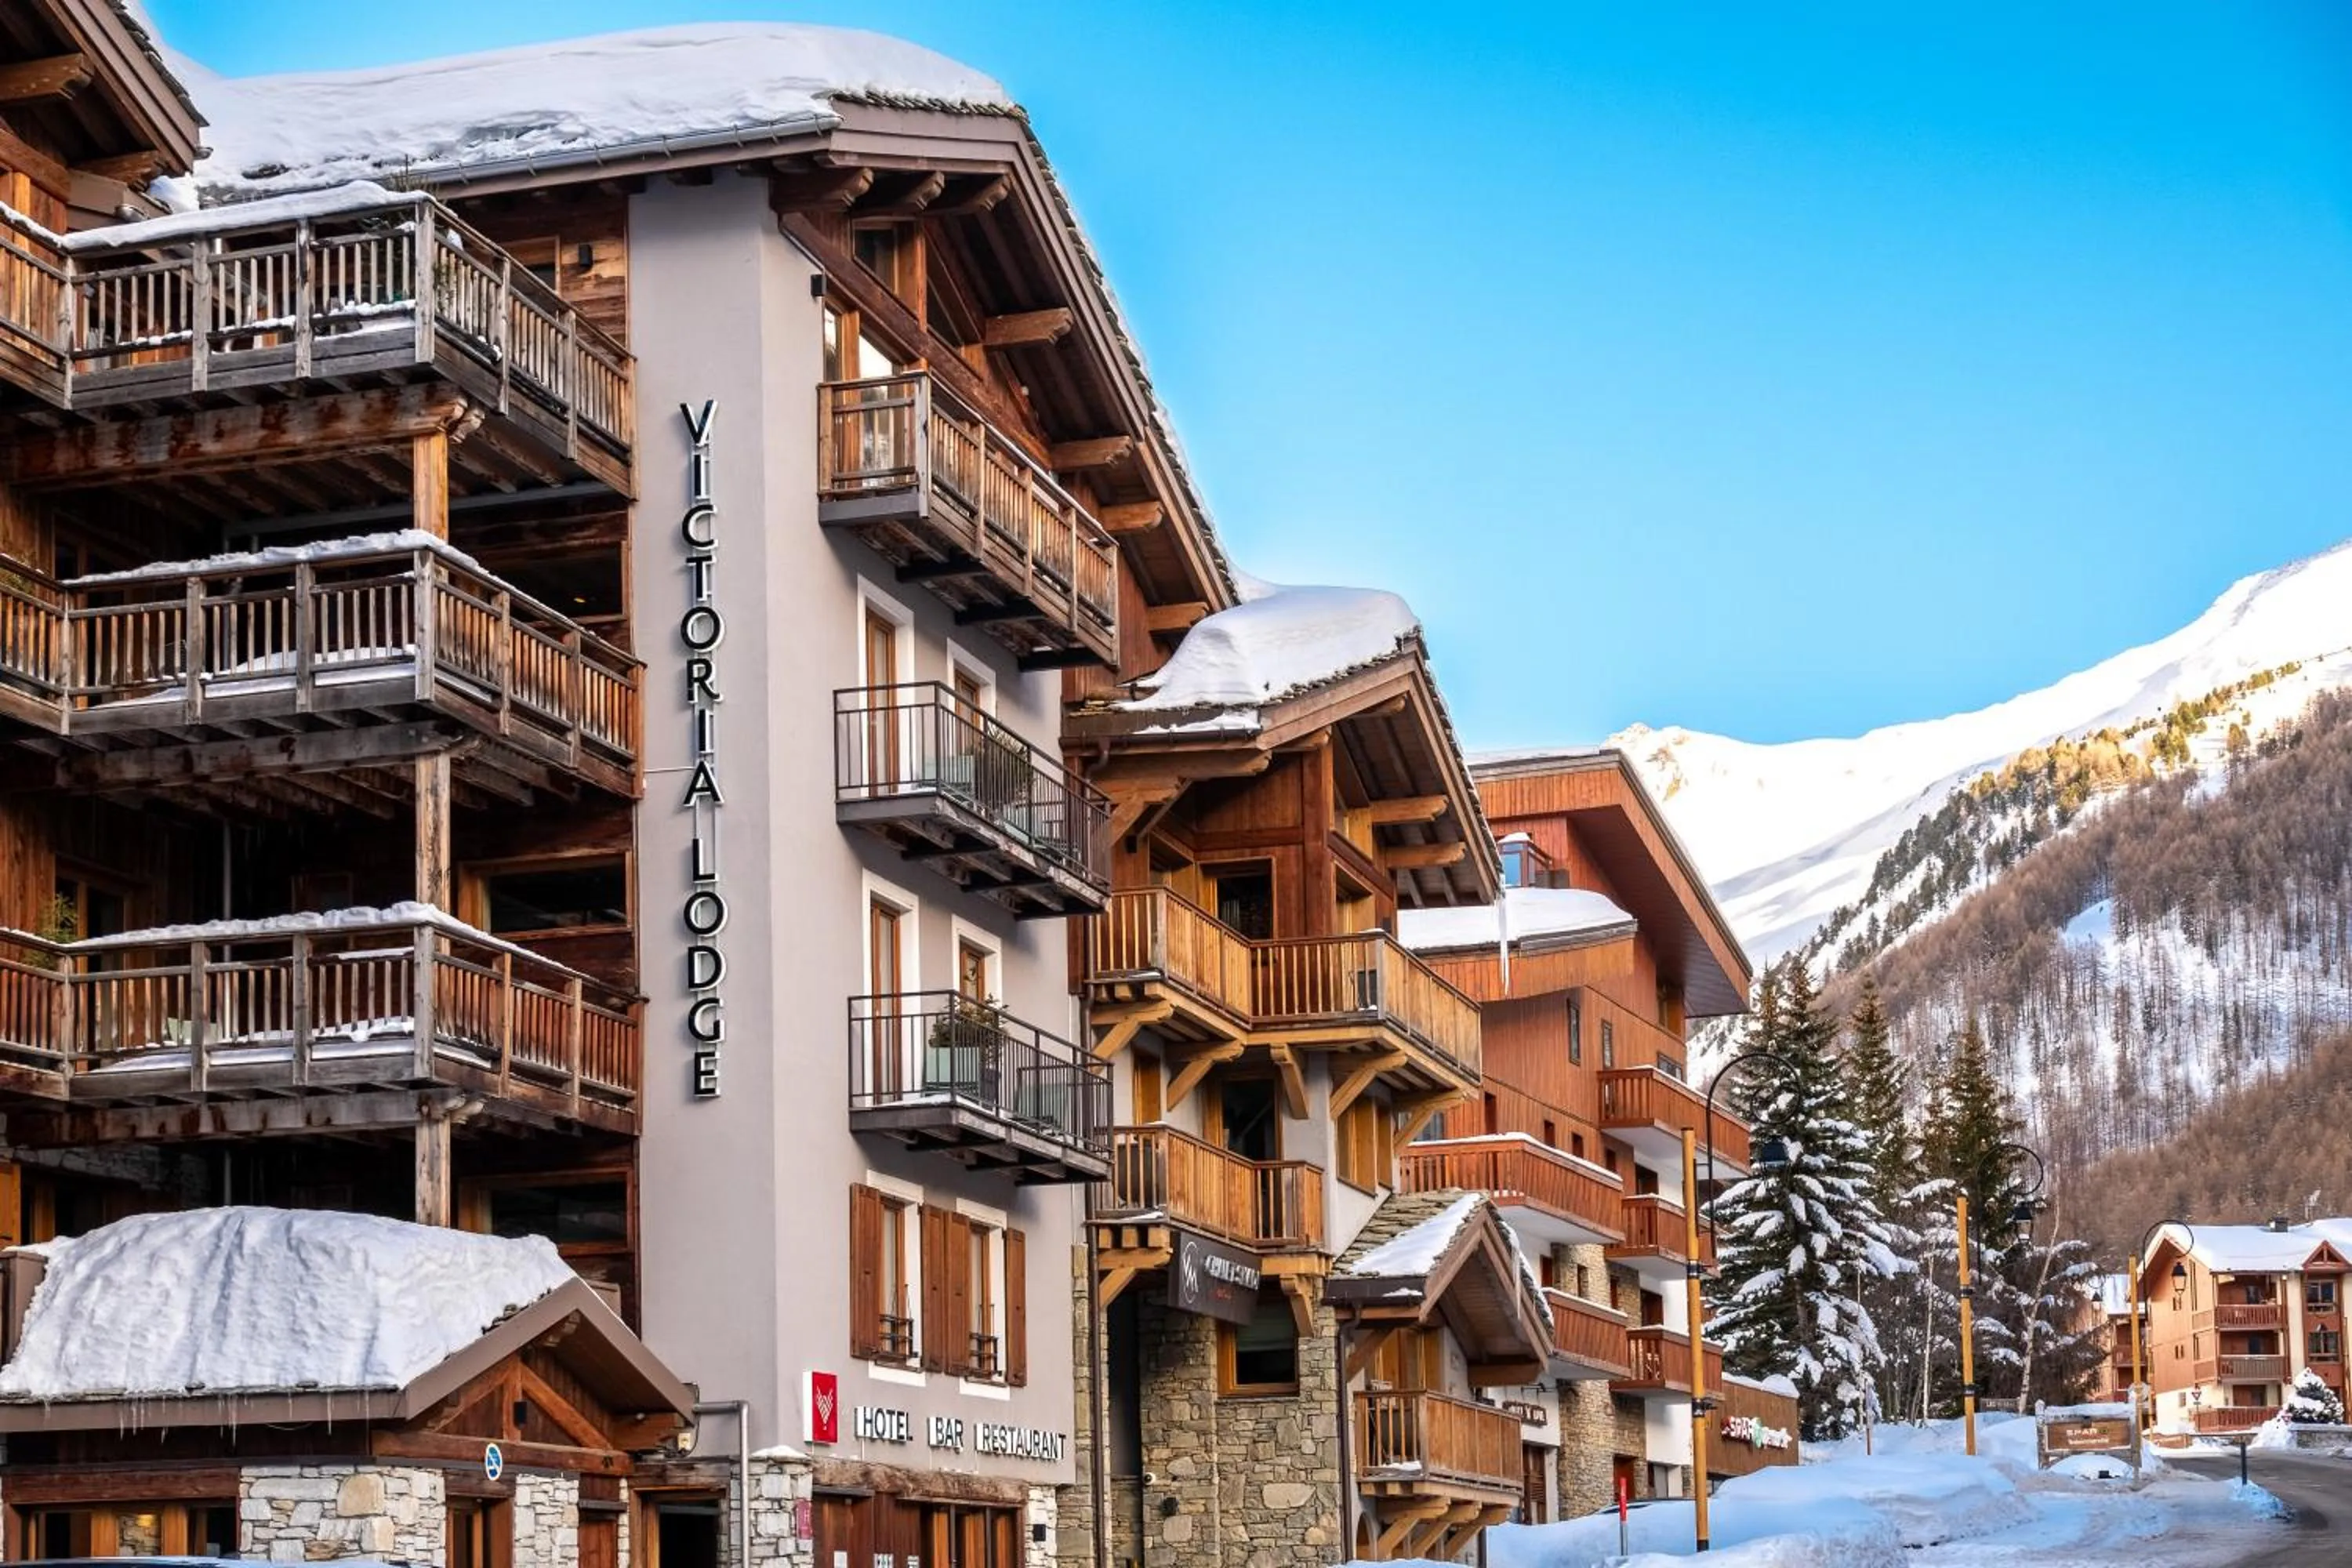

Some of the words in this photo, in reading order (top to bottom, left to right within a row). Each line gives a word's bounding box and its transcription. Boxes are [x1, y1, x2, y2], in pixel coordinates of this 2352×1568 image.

[680, 399, 725, 807] VICTORIA
[684, 838, 728, 1097] LODGE
[863, 1406, 913, 1441] HOTEL
[935, 1417, 964, 1447] BAR
[982, 1423, 1066, 1460] RESTAURANT
[1729, 1416, 1757, 1441] SPAR
